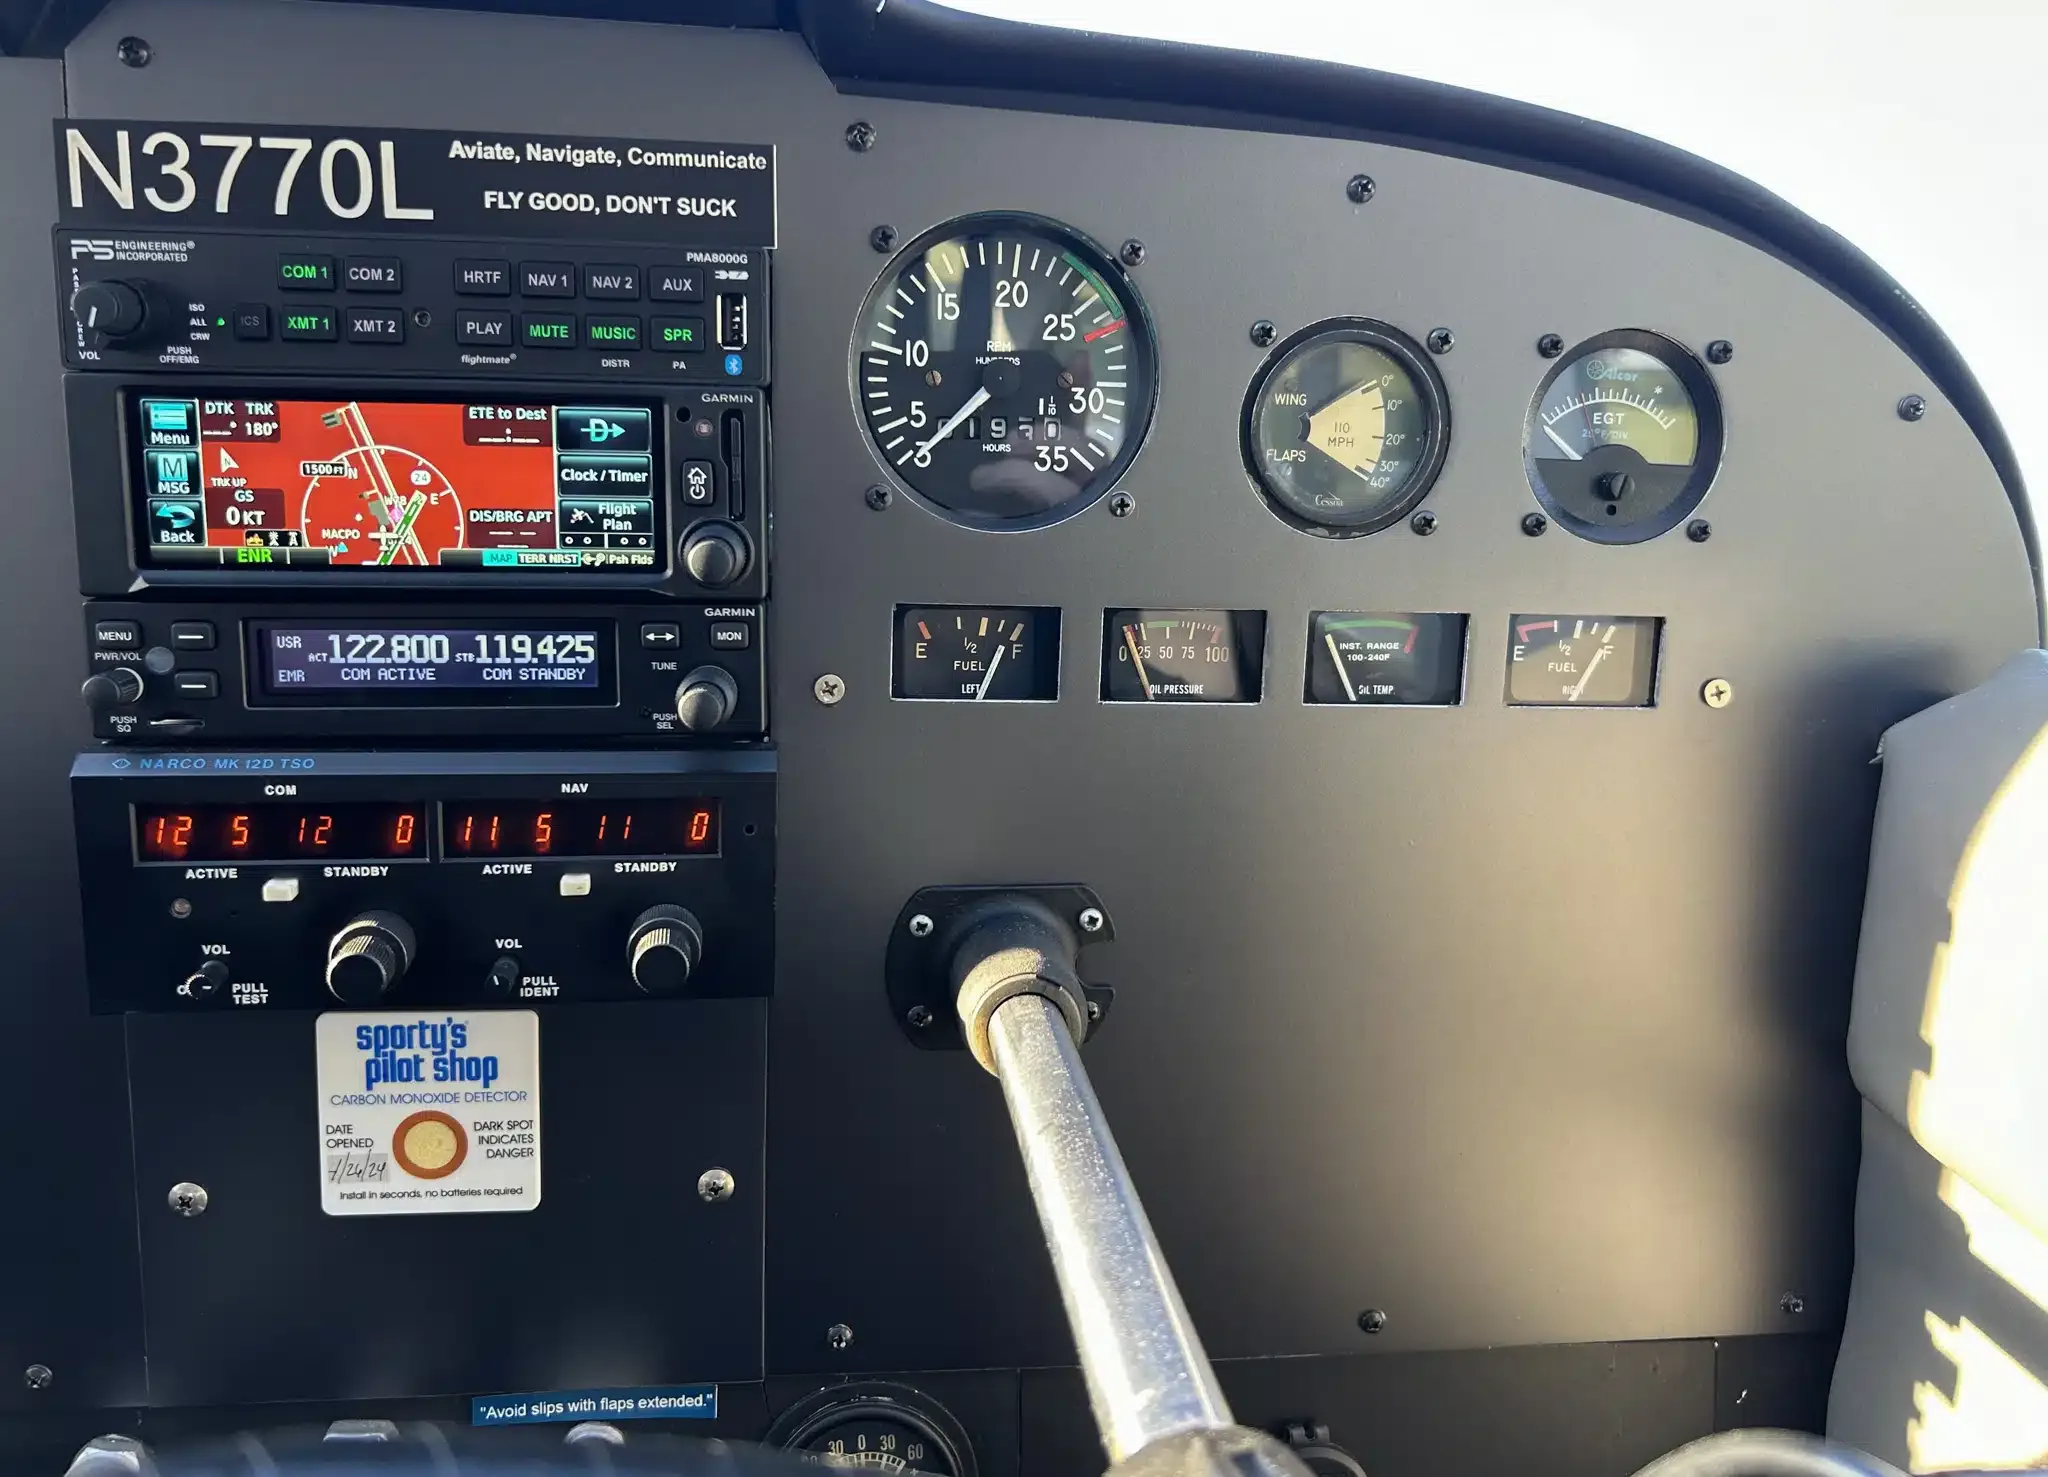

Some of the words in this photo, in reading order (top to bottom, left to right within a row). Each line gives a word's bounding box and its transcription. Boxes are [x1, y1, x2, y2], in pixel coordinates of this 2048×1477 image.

[449, 140, 520, 164] Aviate,
[526, 143, 622, 168] Navigate,
[627, 147, 767, 170] Communicate
[66, 129, 434, 220] N3770L
[484, 190, 523, 210] FLY
[528, 192, 600, 215] GOOD,
[606, 195, 671, 215] DON'T
[676, 197, 737, 217] SUCK
[116, 251, 188, 262] INCORPORATED
[686, 252, 748, 264] PMA8000G
[282, 265, 317, 280] COM
[320, 265, 328, 280] 1
[349, 266, 383, 282] COM
[385, 267, 395, 282] 2
[464, 270, 501, 284] HRTF
[528, 274, 557, 287] NAV
[561, 274, 568, 288] 1
[592, 276, 622, 289] NAV
[624, 277, 633, 290] 2
[663, 278, 693, 292] AUX
[994, 280, 1029, 308] 20
[189, 303, 205, 312] ISO
[937, 293, 960, 321] 15
[190, 318, 207, 326] ALL
[287, 317, 318, 330] XMT
[323, 317, 329, 331] 1
[354, 319, 384, 332] XMT
[388, 320, 396, 333] 2
[466, 321, 502, 335] PLAY
[1042, 313, 1076, 341] 25
[190, 332, 210, 341] CRW
[529, 325, 568, 338] MUTE
[592, 326, 636, 340] MUSIC
[663, 328, 693, 342] SPR
[167, 346, 193, 355] PUSH
[987, 340, 1012, 352] RPM
[79, 351, 100, 360] VOL
[159, 355, 200, 364] OFF/EMG
[905, 340, 929, 367] 10
[601, 358, 631, 368] DISTR
[673, 360, 686, 370] PA
[701, 393, 753, 404] GARMIN
[1069, 387, 1104, 414] 30
[1275, 393, 1307, 406] WING
[205, 401, 235, 415] DTK
[245, 402, 274, 416] TRK
[469, 407, 494, 420] ETE
[497, 407, 512, 420] to
[516, 407, 547, 420] Dest
[909, 401, 928, 428] 5
[1593, 412, 1625, 425] EGT
[245, 422, 278, 436] 180°
[1334, 422, 1350, 433] 110
[151, 432, 190, 445] Menu
[1327, 437, 1354, 448] MPH
[982, 443, 1011, 453] HOURS
[1034, 445, 1069, 472] 35
[1266, 449, 1306, 462] FLAPS
[560, 468, 598, 482] Clock
[608, 469, 648, 482] Timer
[158, 482, 190, 495] MSG
[211, 477, 230, 488] TRK
[232, 477, 247, 488] UP
[234, 489, 254, 503] GS
[598, 502, 637, 517] Flight
[469, 509, 524, 523] DIS/BRG
[527, 510, 553, 523] APT
[603, 518, 632, 531] Plan
[161, 530, 195, 543] Back
[321, 528, 360, 540] MACPO
[236, 548, 273, 563] ENR
[490, 552, 512, 563] MAP
[518, 553, 547, 564] TERR
[549, 553, 578, 564] NRST
[609, 553, 628, 564] Psh
[705, 607, 755, 617] GARMIN
[99, 631, 132, 642] MENU
[717, 631, 742, 641] MON
[277, 635, 302, 649] USR
[328, 634, 449, 664] 122.800
[475, 634, 595, 664] 119.425
[916, 642, 928, 659] E
[1012, 644, 1023, 659] F
[1340, 642, 1362, 650] INST.
[1367, 642, 1399, 650] RANGE
[94, 652, 142, 662] PWR/VOL
[308, 652, 328, 662] ACT
[455, 652, 475, 663] STB
[1159, 646, 1173, 659] 50
[1182, 646, 1195, 659] 75
[1205, 646, 1229, 662] 100
[1347, 653, 1390, 661] 100-240F
[1513, 645, 1525, 661] E
[651, 662, 678, 671] TUNE
[953, 660, 985, 671] FUEL
[1548, 662, 1577, 672] FUEL
[278, 670, 305, 682] EMR
[341, 668, 370, 681] COM
[378, 668, 436, 681] ACTIVE
[482, 668, 512, 681] COM
[519, 668, 585, 681] STANDBY
[962, 684, 980, 694] LEFT
[1150, 684, 1161, 694] OIL
[1164, 684, 1204, 695] PRESSURE
[110, 716, 137, 725] PUSH
[653, 713, 678, 721] PUSH
[117, 725, 132, 733] SQ
[656, 722, 674, 730] SEL
[139, 758, 206, 770] NARCO
[214, 758, 239, 770] MK
[245, 758, 274, 770] 12D
[281, 758, 316, 770] TSO
[264, 785, 297, 796] COM
[561, 783, 589, 793] NAV
[323, 866, 389, 878] STANDBY
[482, 863, 533, 875] ACTIVE
[614, 861, 677, 873] STANDBY
[186, 868, 238, 879] ACTIVE
[201, 944, 231, 955] VOL
[495, 938, 523, 949] VOL
[522, 976, 557, 986] PULL
[232, 983, 268, 993] PULL
[519, 986, 560, 997] IDENT
[232, 994, 269, 1005] TEST
[356, 1017, 468, 1057] sporty's
[365, 1050, 425, 1091] pilot
[433, 1050, 498, 1089] shop
[330, 1094, 386, 1106] CARBON
[390, 1093, 460, 1104] MONOXIDE
[464, 1091, 527, 1103] DETECTOR
[326, 1124, 353, 1135] DATE
[473, 1121, 504, 1131] DARK
[506, 1120, 533, 1130] SPOT
[326, 1138, 374, 1149] OPENED
[478, 1134, 534, 1145] INDICATES
[486, 1148, 534, 1159] DANGER
[340, 1191, 366, 1200] Install
[380, 1189, 423, 1199] seconds,
[425, 1190, 439, 1198] no
[440, 1188, 481, 1198] batteries
[483, 1186, 523, 1198] required
[531, 1400, 564, 1417] slips
[568, 1398, 596, 1412] with
[601, 1397, 634, 1412] flaps
[828, 1440, 844, 1455] 30
[857, 1434, 866, 1450] 0
[880, 1434, 896, 1450] 30
[908, 1443, 924, 1460] 60
